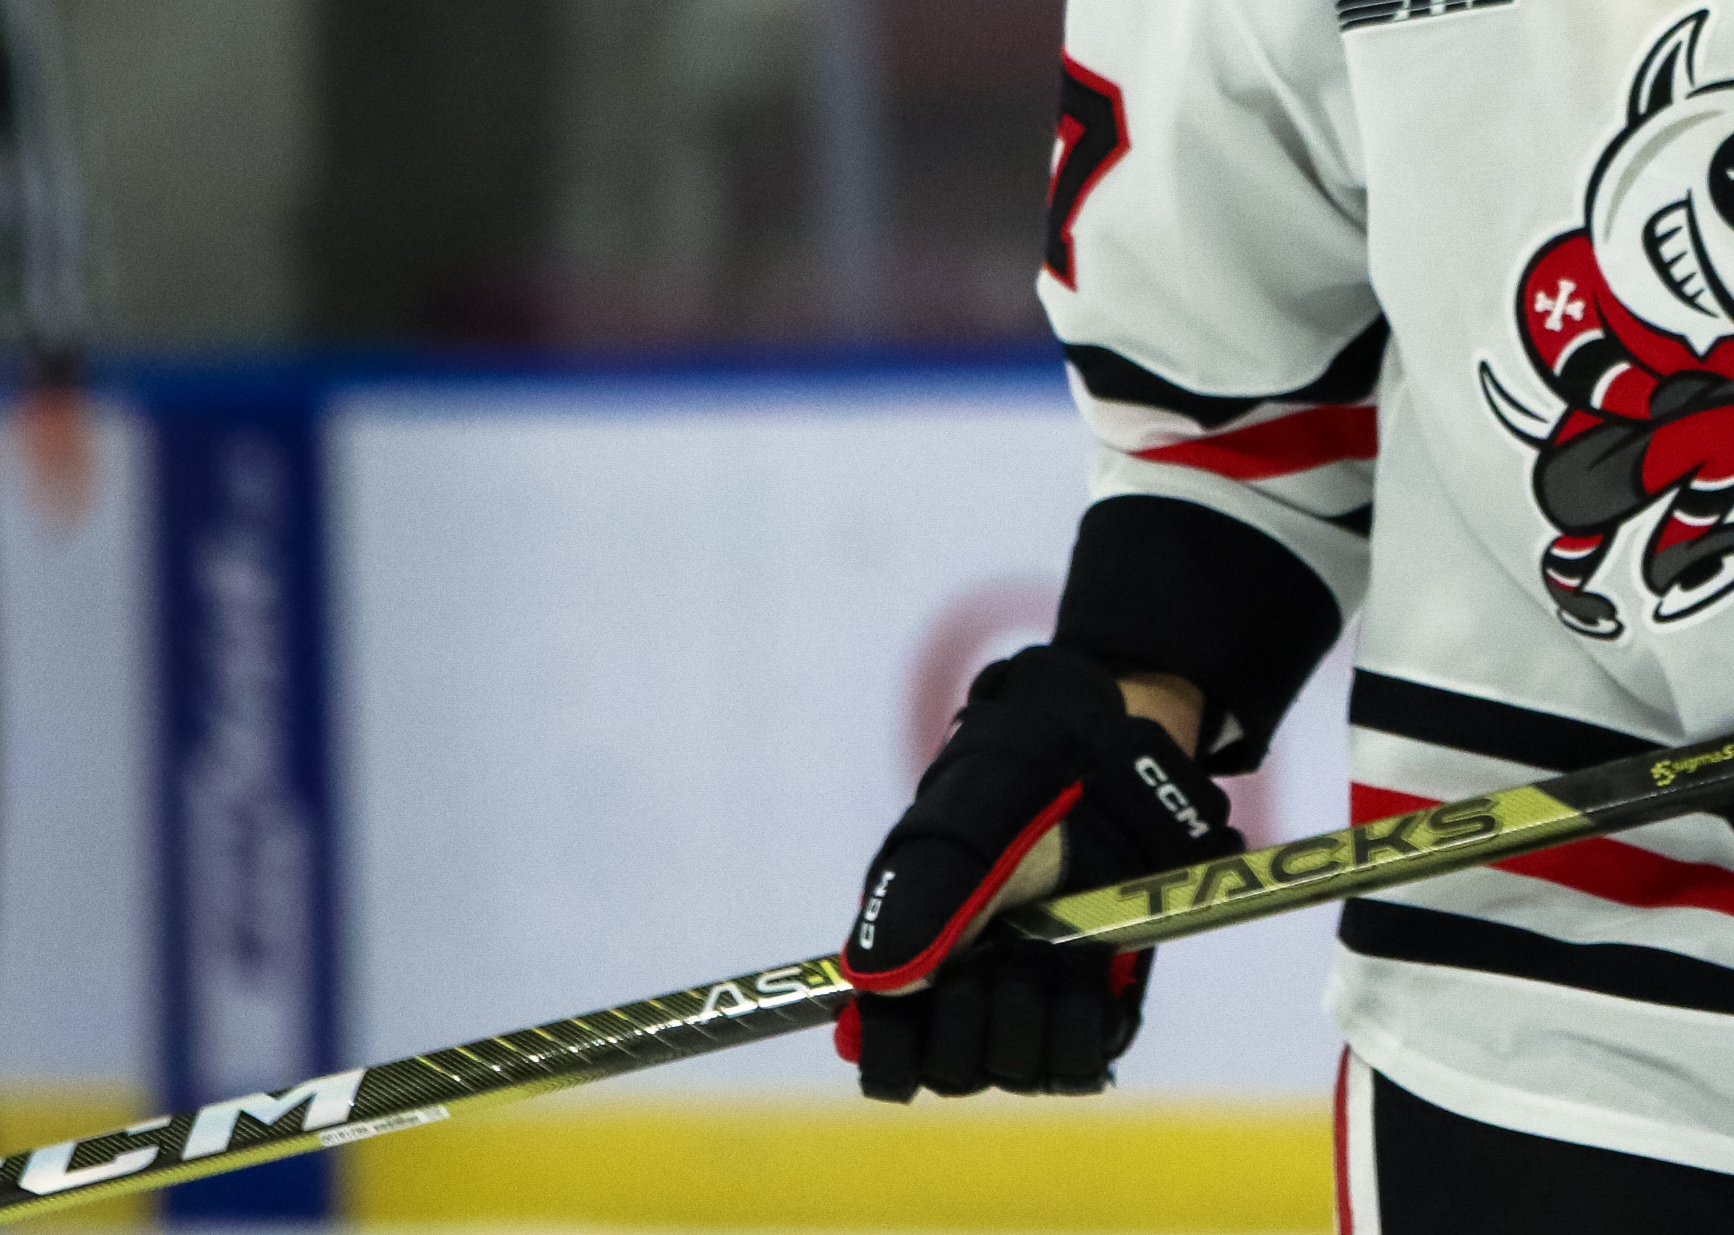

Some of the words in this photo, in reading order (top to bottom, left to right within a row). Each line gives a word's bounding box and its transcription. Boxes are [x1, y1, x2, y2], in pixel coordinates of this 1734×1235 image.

[1134, 755, 1209, 838] CCM
[859, 869, 896, 951] CCM
[1120, 796, 1502, 922] TACKS
[0, 1068, 366, 1196] CM
